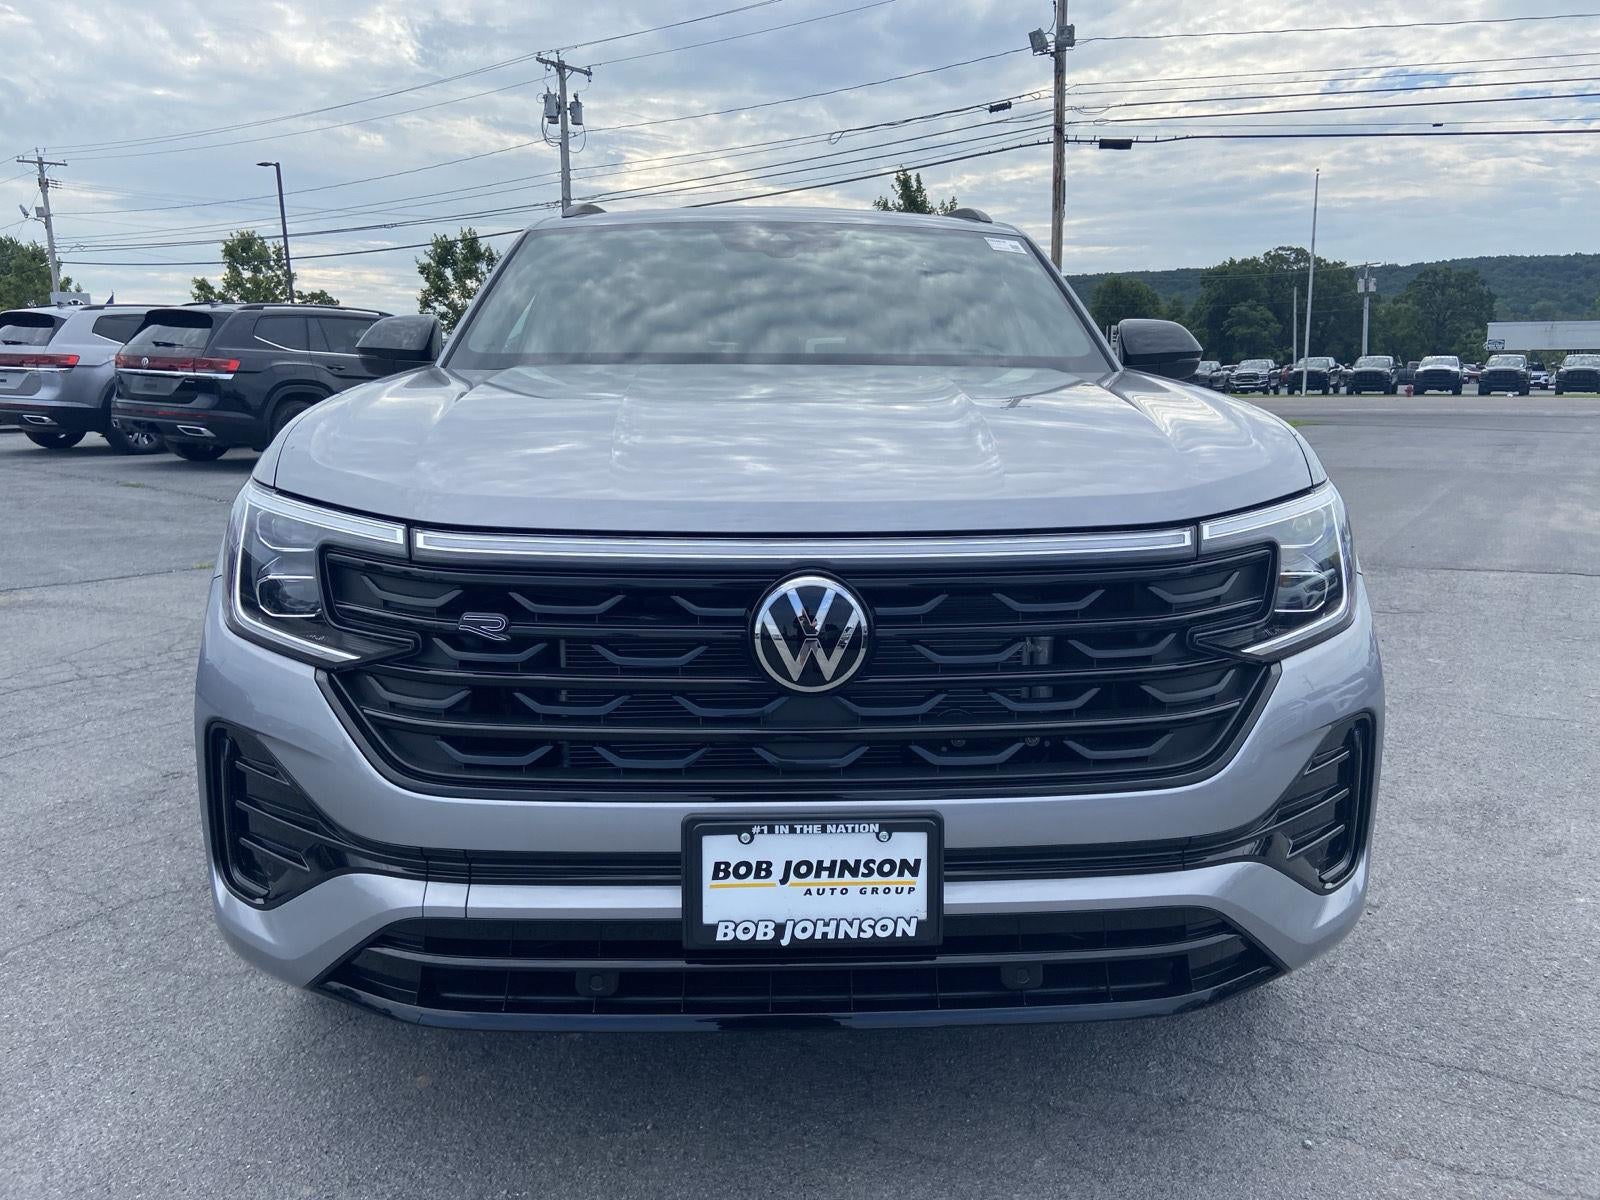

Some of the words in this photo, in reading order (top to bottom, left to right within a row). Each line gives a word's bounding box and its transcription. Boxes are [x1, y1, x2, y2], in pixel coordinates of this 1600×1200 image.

[752, 825, 768, 834] #1
[774, 825, 791, 834] IN
[795, 825, 822, 834] THE
[826, 824, 880, 834] NATION
[711, 861, 773, 881] BOB
[779, 858, 922, 885] JOHNSON
[803, 887, 849, 896] AUTO
[859, 886, 916, 895] GROUP
[715, 920, 776, 941] BOB
[780, 917, 919, 946] JOHNSON
